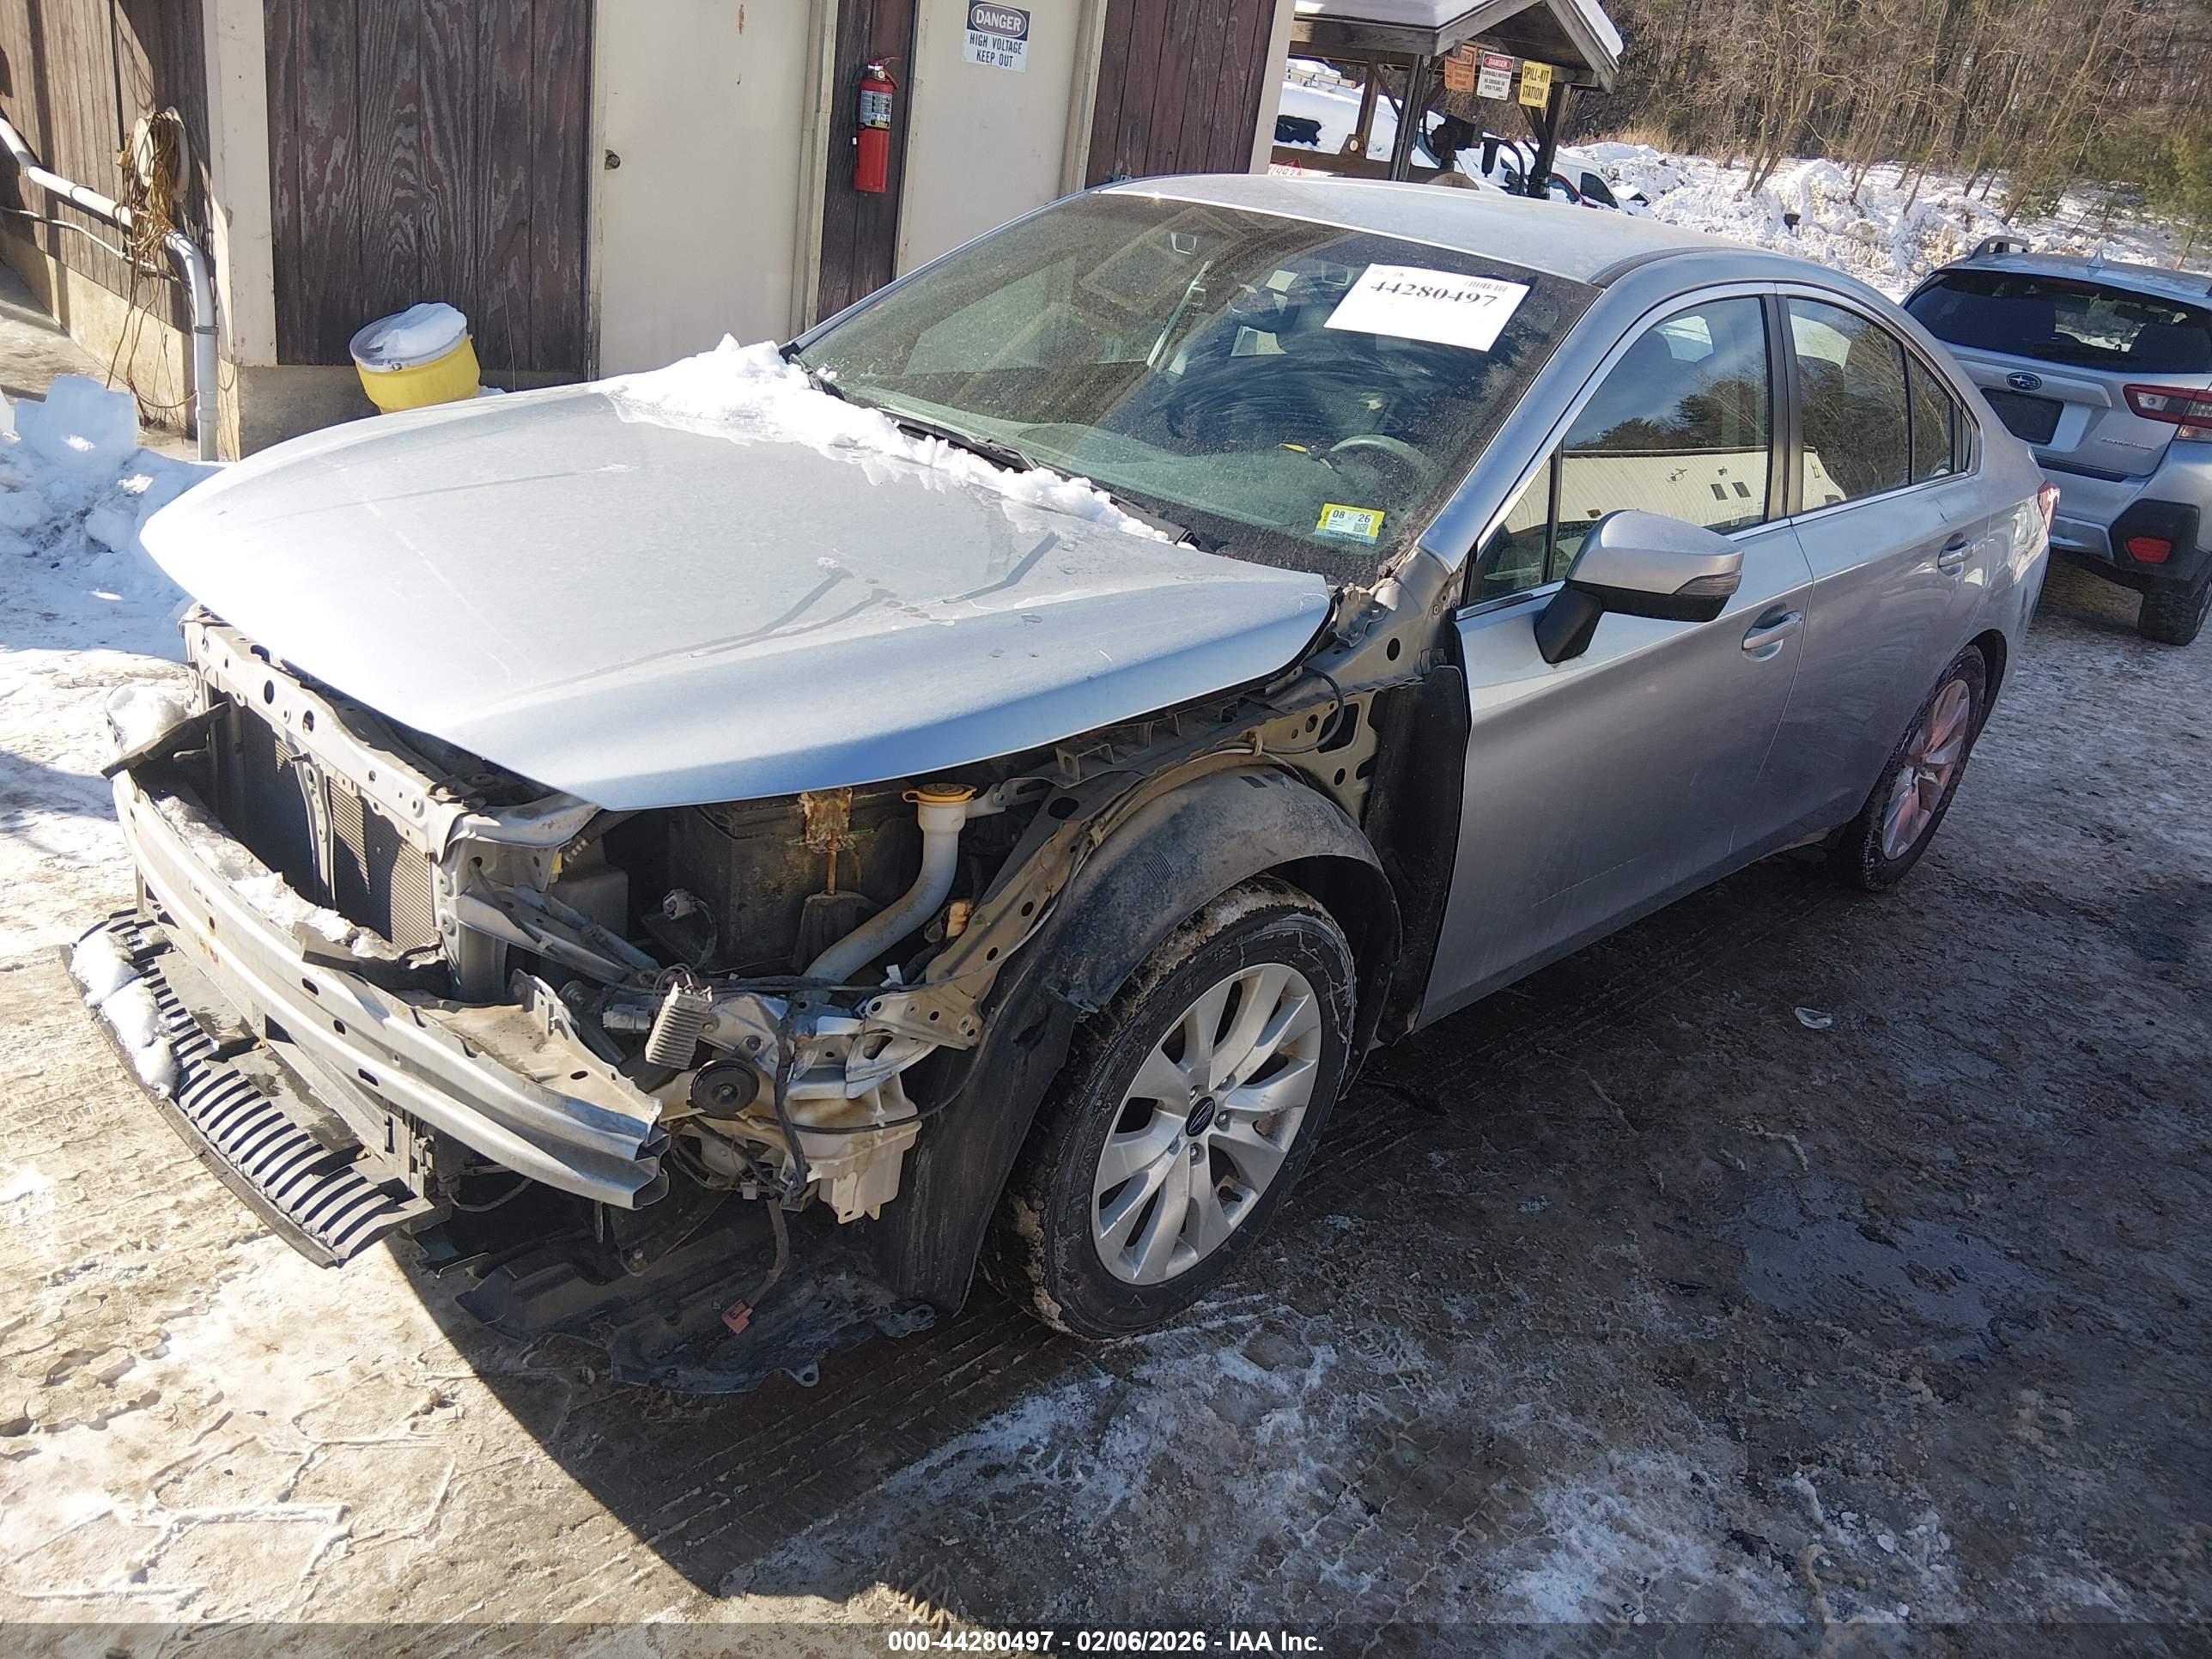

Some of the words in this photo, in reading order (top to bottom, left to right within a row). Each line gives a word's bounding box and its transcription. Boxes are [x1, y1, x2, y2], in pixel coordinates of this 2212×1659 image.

[975, 9, 1022, 32] DANGER
[969, 32, 988, 48] HIGH
[992, 37, 1023, 55] VOLTAGE
[976, 49, 995, 65] KEEP
[999, 54, 1013, 68] OUT
[1488, 58, 1508, 68] DANGER
[1523, 65, 1550, 84] SPILL-KIT
[1522, 84, 1545, 101] STATION
[1370, 281, 1498, 307] 44280497
[1332, 509, 1346, 520] 08
[1358, 514, 1371, 523] 26
